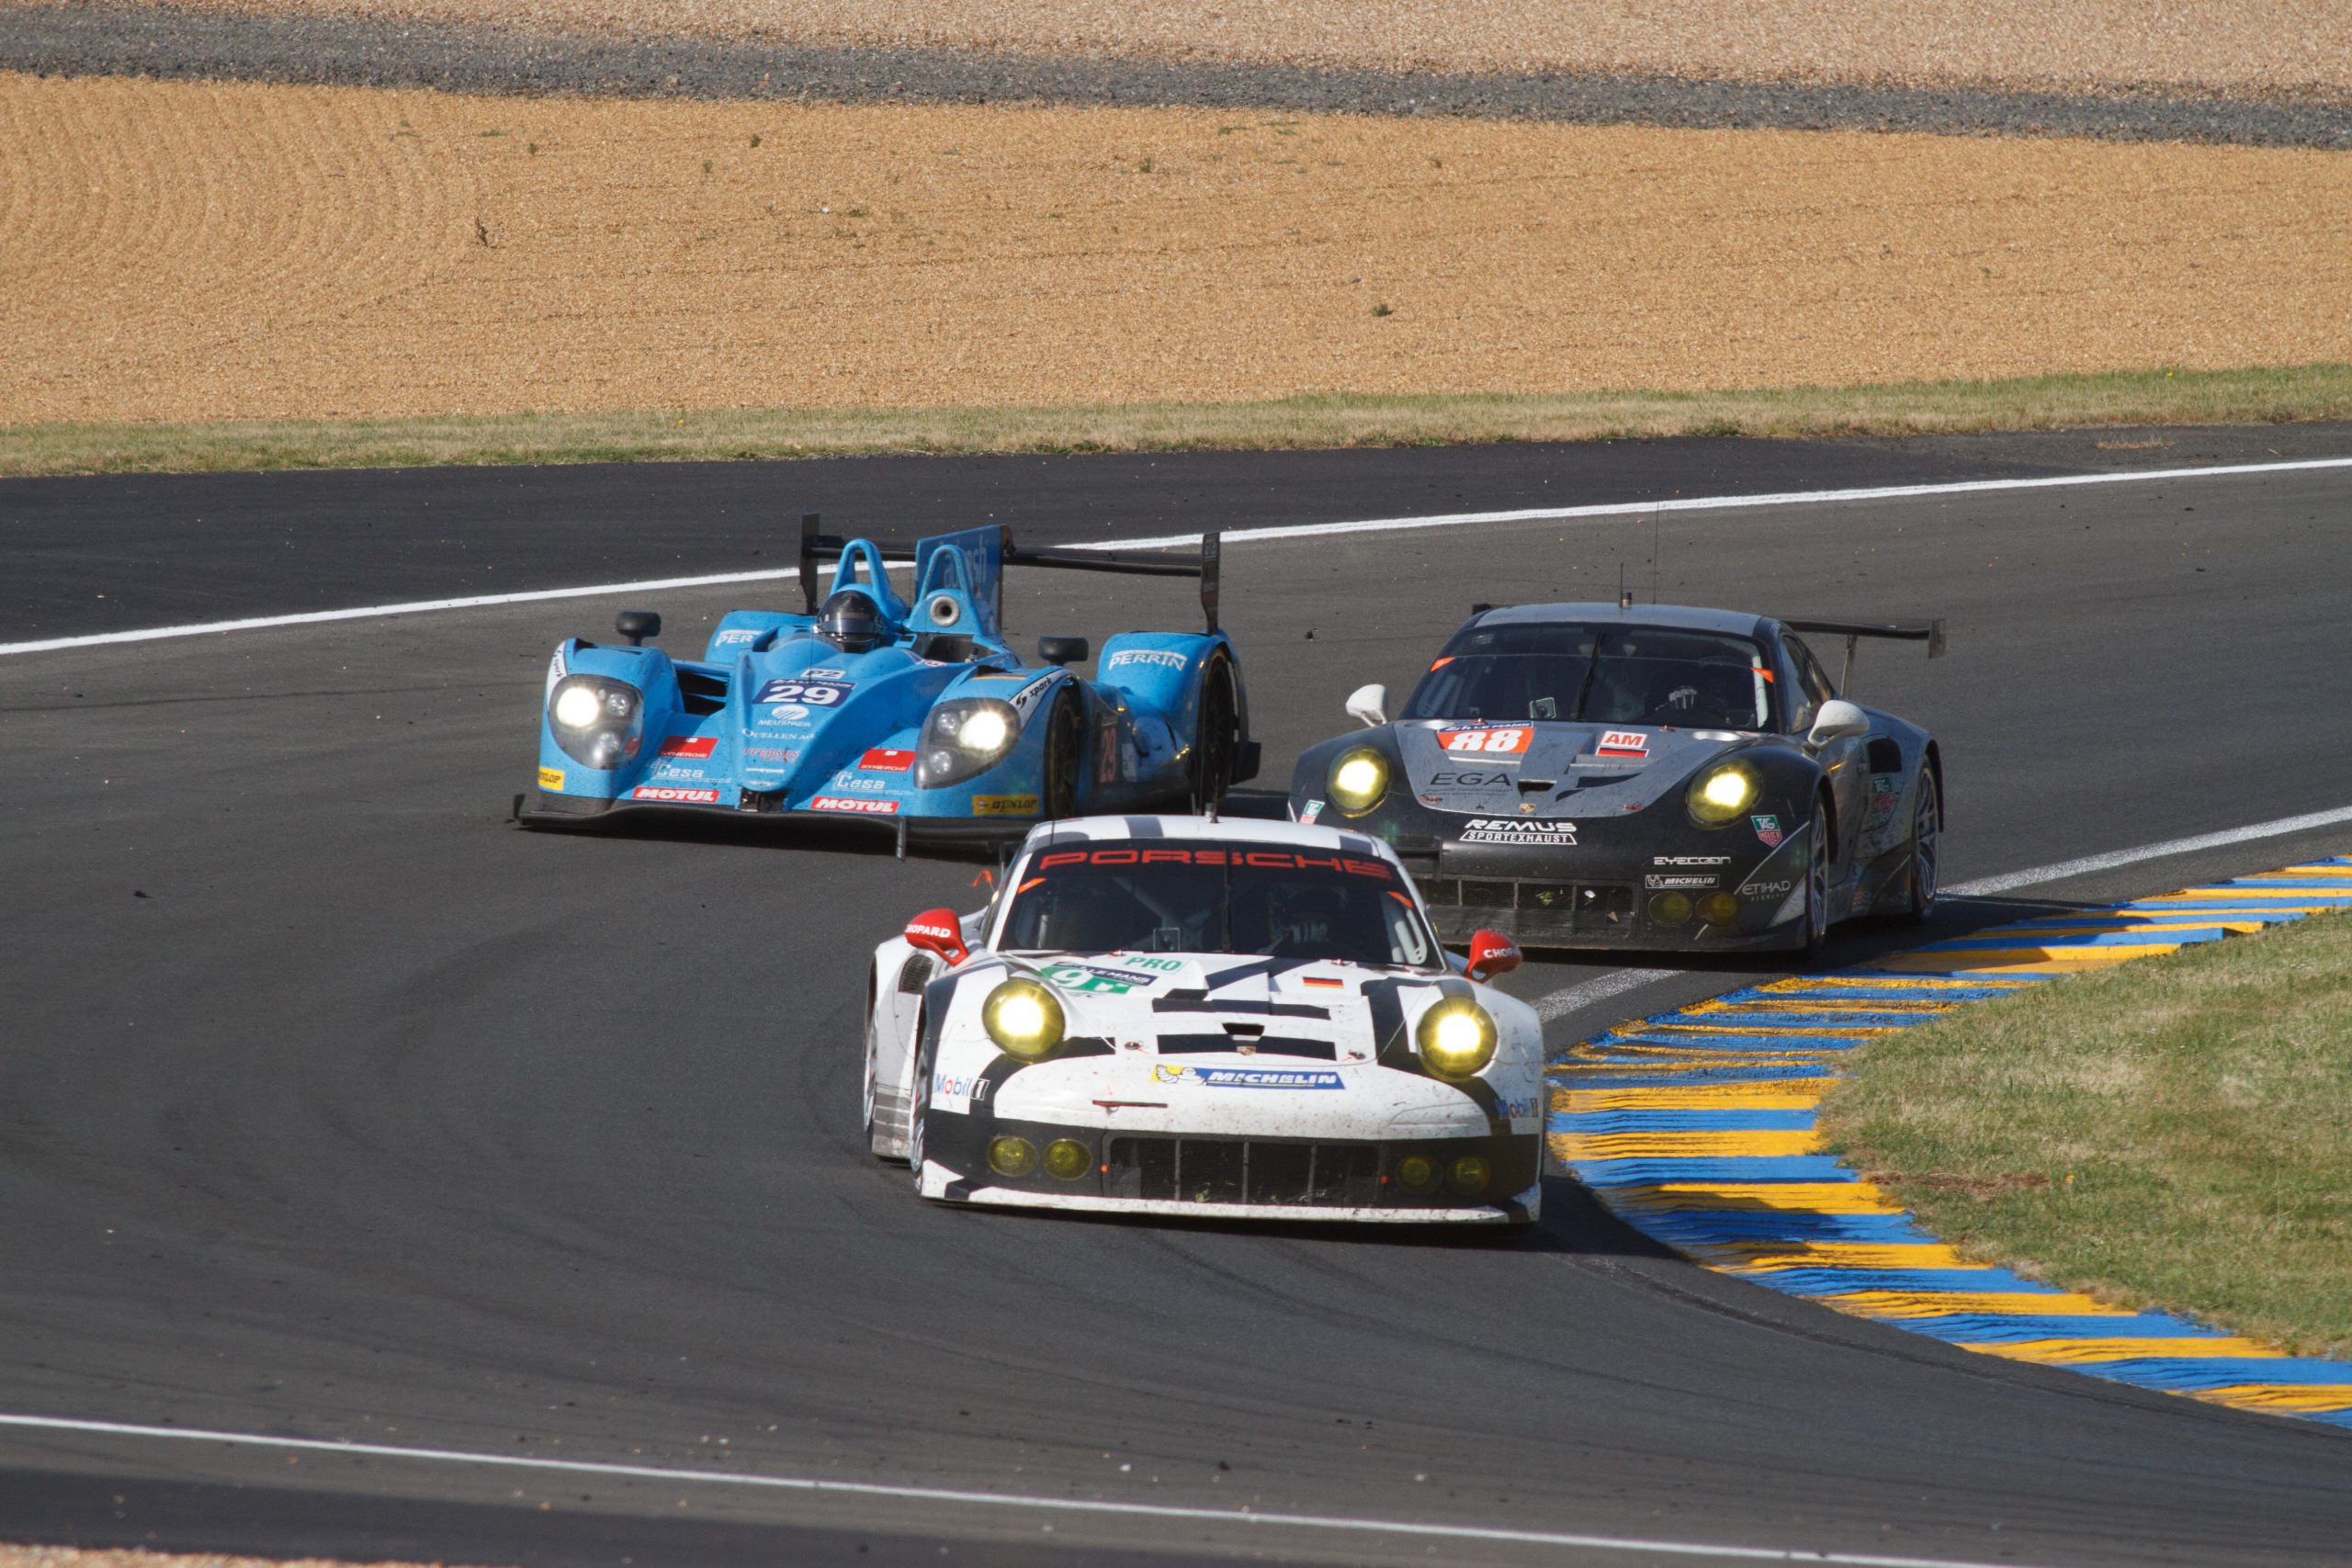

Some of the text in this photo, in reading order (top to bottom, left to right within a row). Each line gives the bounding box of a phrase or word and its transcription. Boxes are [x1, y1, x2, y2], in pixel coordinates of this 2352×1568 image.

[1108, 654, 1187, 671] PERRIN
[1030, 676, 1052, 698] spark
[763, 685, 840, 705] 29
[1447, 729, 1523, 752] 88
[1604, 734, 1642, 746] AM
[1430, 773, 1511, 786] EGA
[637, 788, 714, 801] MOTUL
[815, 798, 893, 812] MOTUL
[992, 799, 1037, 812] DUNLOP
[1464, 819, 1577, 832] REMUS
[1757, 818, 1775, 829] TAG
[1468, 831, 1567, 843] SPORTEXHAUST
[1039, 850, 1393, 881] PORSCHE
[1742, 880, 1791, 896] ETIHAD
[1125, 957, 1182, 971] PRO
[1107, 971, 1148, 984] MANS
[1209, 1071, 1338, 1084] MICHELIN
[933, 1073, 973, 1097] Mobil
